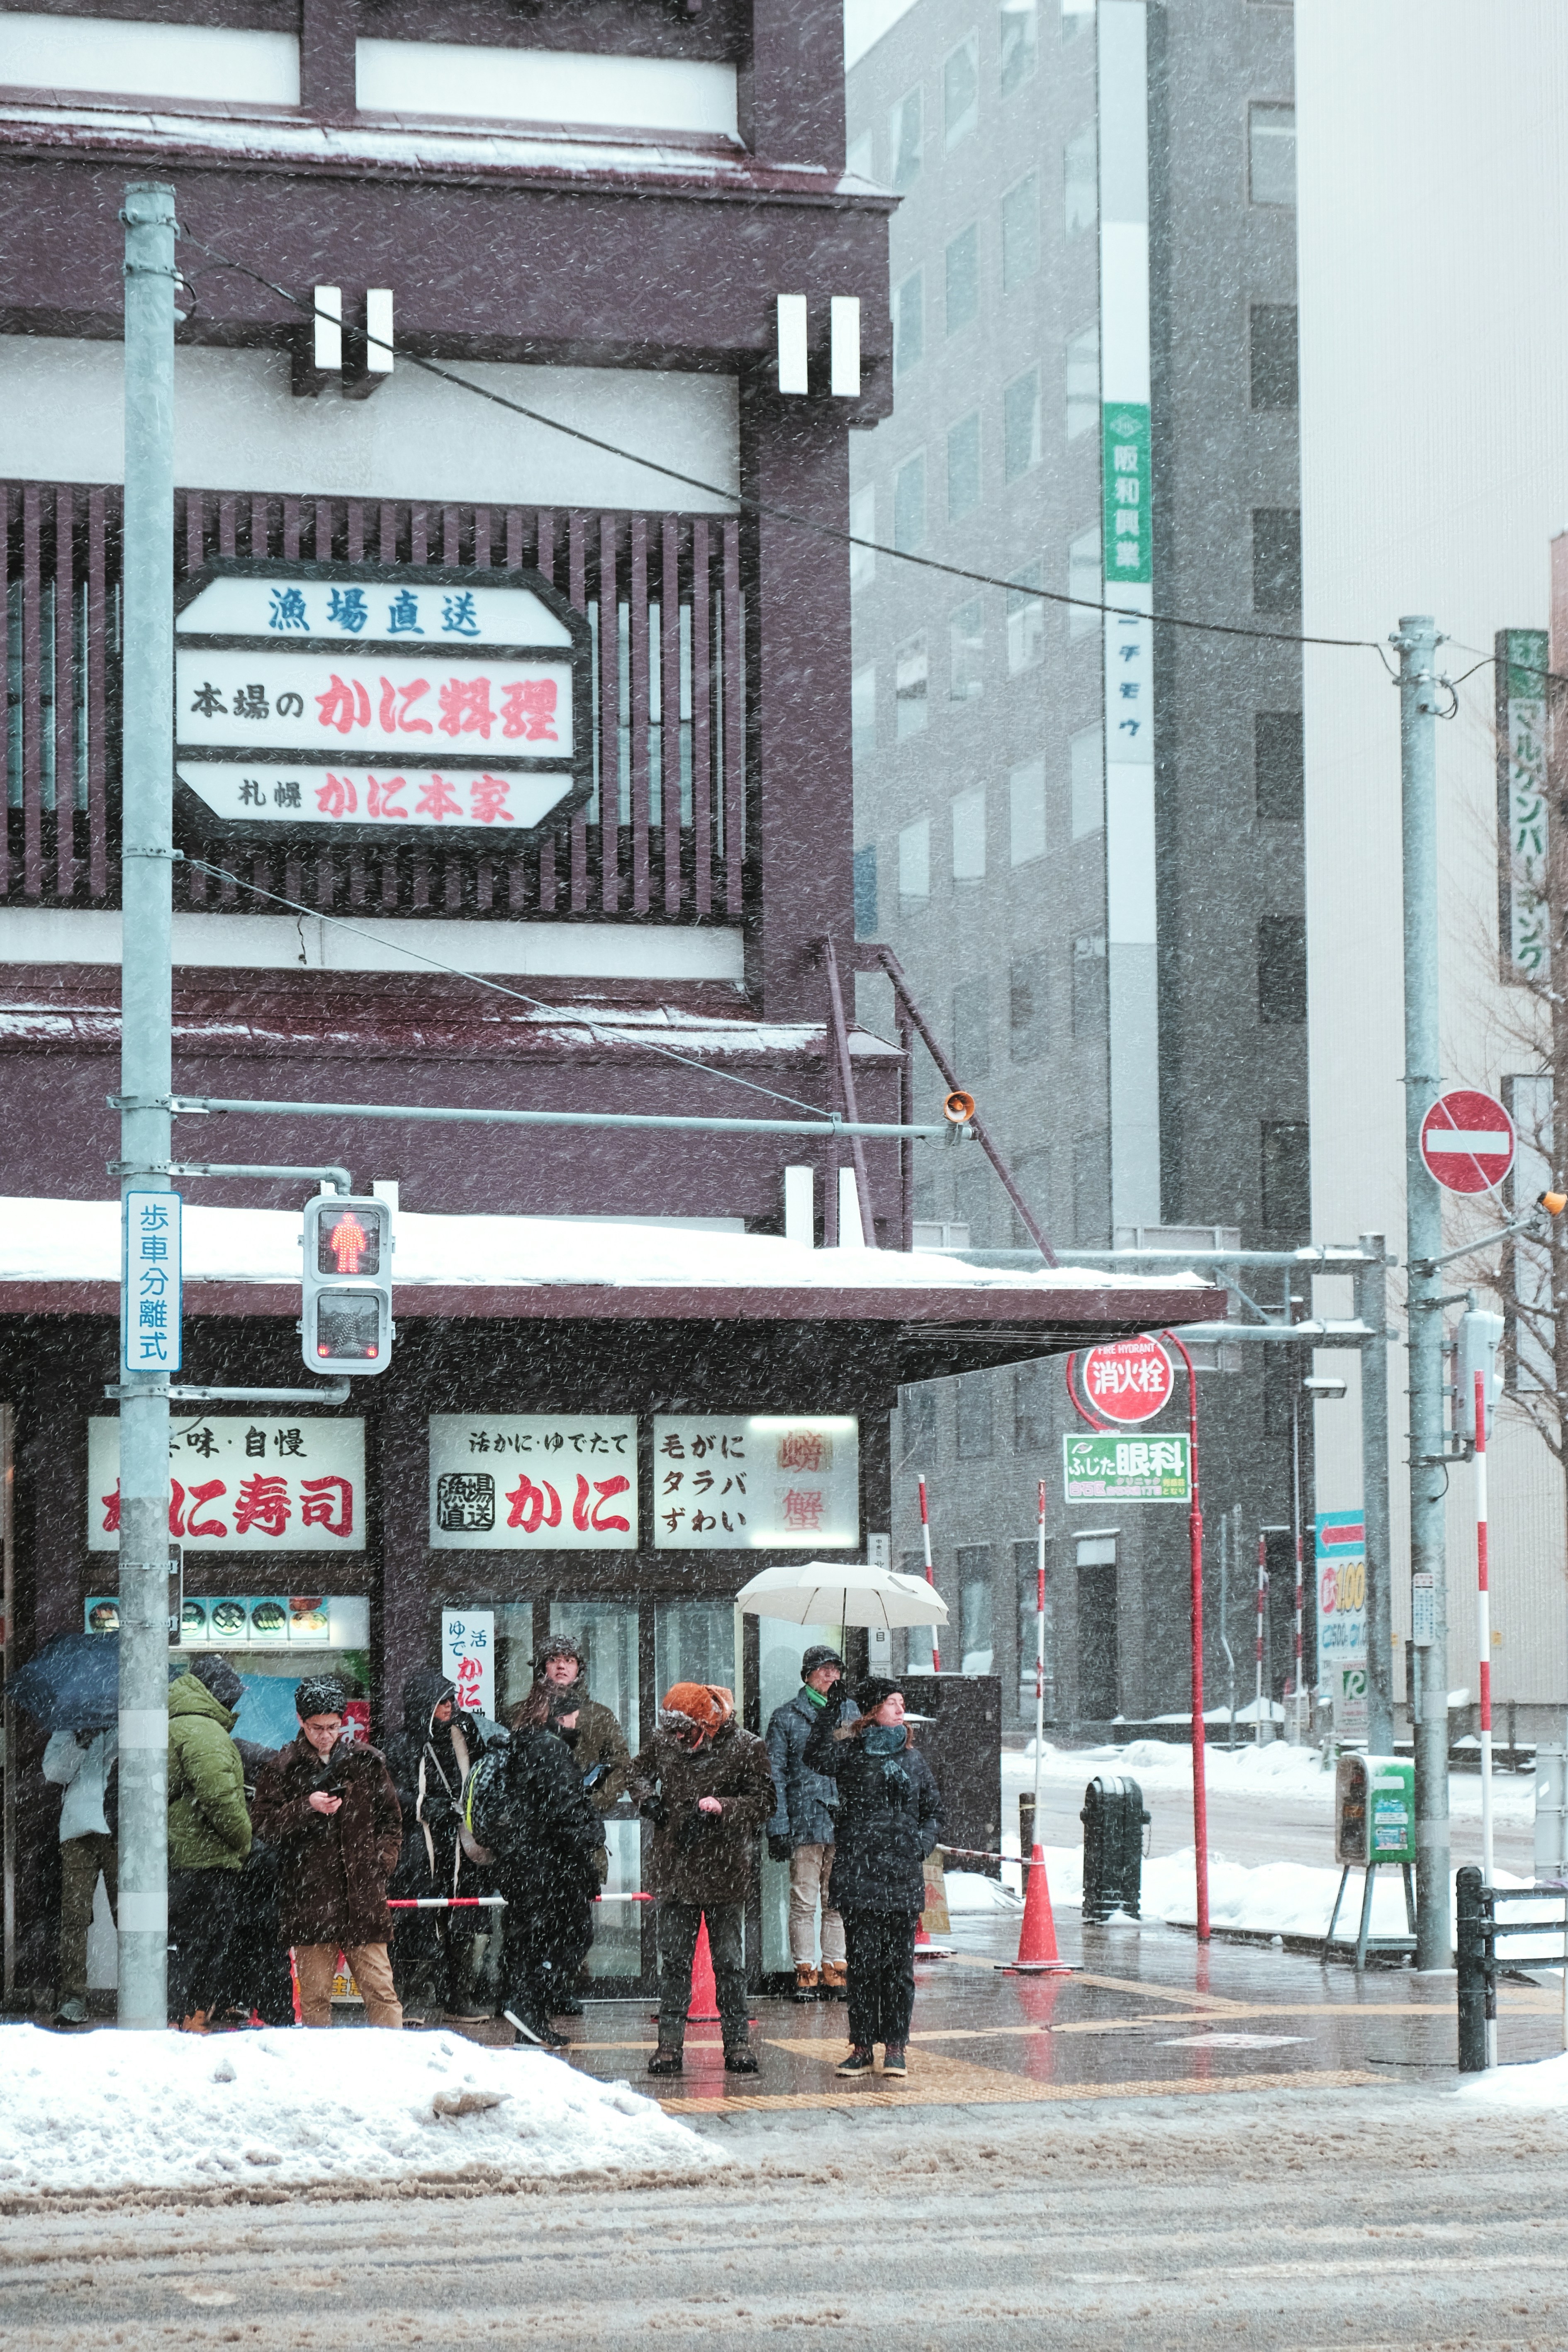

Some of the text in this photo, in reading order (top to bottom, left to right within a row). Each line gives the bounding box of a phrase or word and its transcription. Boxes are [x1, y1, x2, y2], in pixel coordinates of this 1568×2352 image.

[268, 587, 481, 636] 漁場直送
[190, 674, 559, 741] 本場のかに料理
[238, 772, 514, 823] 札幌かに本家
[139, 1204, 169, 1361] 歩車分離式
[1098, 1343, 1155, 1354] FIRE HYDRANT
[1092, 1359, 1165, 1395] 消火栓
[169, 1426, 308, 1458] 味・自慢
[469, 1432, 628, 1455] 活かに・ゆでたて
[659, 1433, 746, 1459] 毛がに
[1069, 1441, 1185, 1477] ふじた眼科
[662, 1470, 747, 1495] タラバ
[1069, 1480, 1106, 1496] 白石区
[505, 1473, 631, 1534] かに
[661, 1507, 747, 1534] ずわい
[449, 1620, 466, 1656] ゆで
[470, 1630, 487, 1647] 活
[457, 1657, 482, 1707] かに
